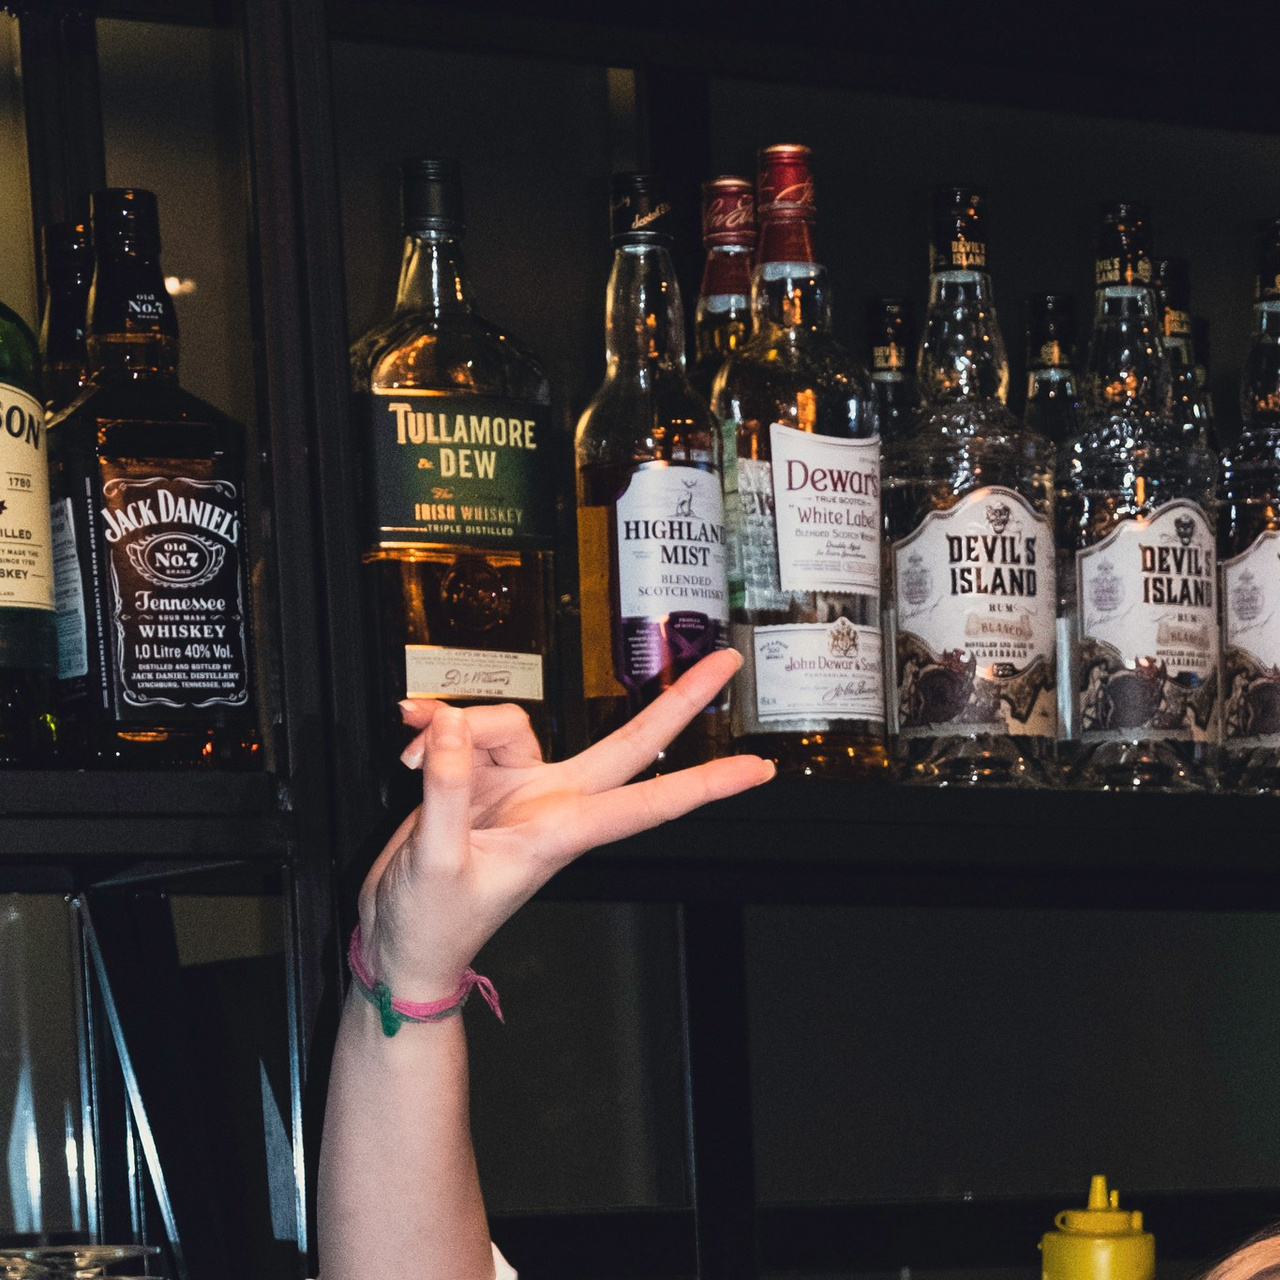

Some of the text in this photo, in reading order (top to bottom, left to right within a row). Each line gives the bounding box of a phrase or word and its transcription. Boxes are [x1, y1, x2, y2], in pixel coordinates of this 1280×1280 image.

[128, 300, 163, 314] No.7
[388, 402, 537, 449] TULLAMORE
[439, 447, 496, 480] DEW
[8, 477, 31, 489] 1780
[786, 460, 879, 498] Dewar's
[101, 489, 241, 546] JACK DANIEL'S
[414, 503, 523, 525] IRISH WHISKEY
[427, 524, 514, 537] TRIPLE DISTILLED
[163, 542, 187, 552] Old
[155, 552, 199, 568] No.7
[660, 545, 710, 566] MIST
[661, 574, 711, 586] BLENDED
[951, 567, 1036, 597] ISLAND
[638, 587, 688, 597] SCOTCH
[1143, 577, 1212, 607] ISLAND
[135, 590, 226, 611] Tennessee
[138, 625, 226, 638] WHISKEY
[153, 643, 181, 659] Litre
[184, 643, 211, 659] 40%
[212, 643, 234, 659] Vol.
[785, 656, 815, 672] John
[818, 656, 853, 669] Dewar
[131, 672, 240, 680] JACK DANIEL DISTILLERY
